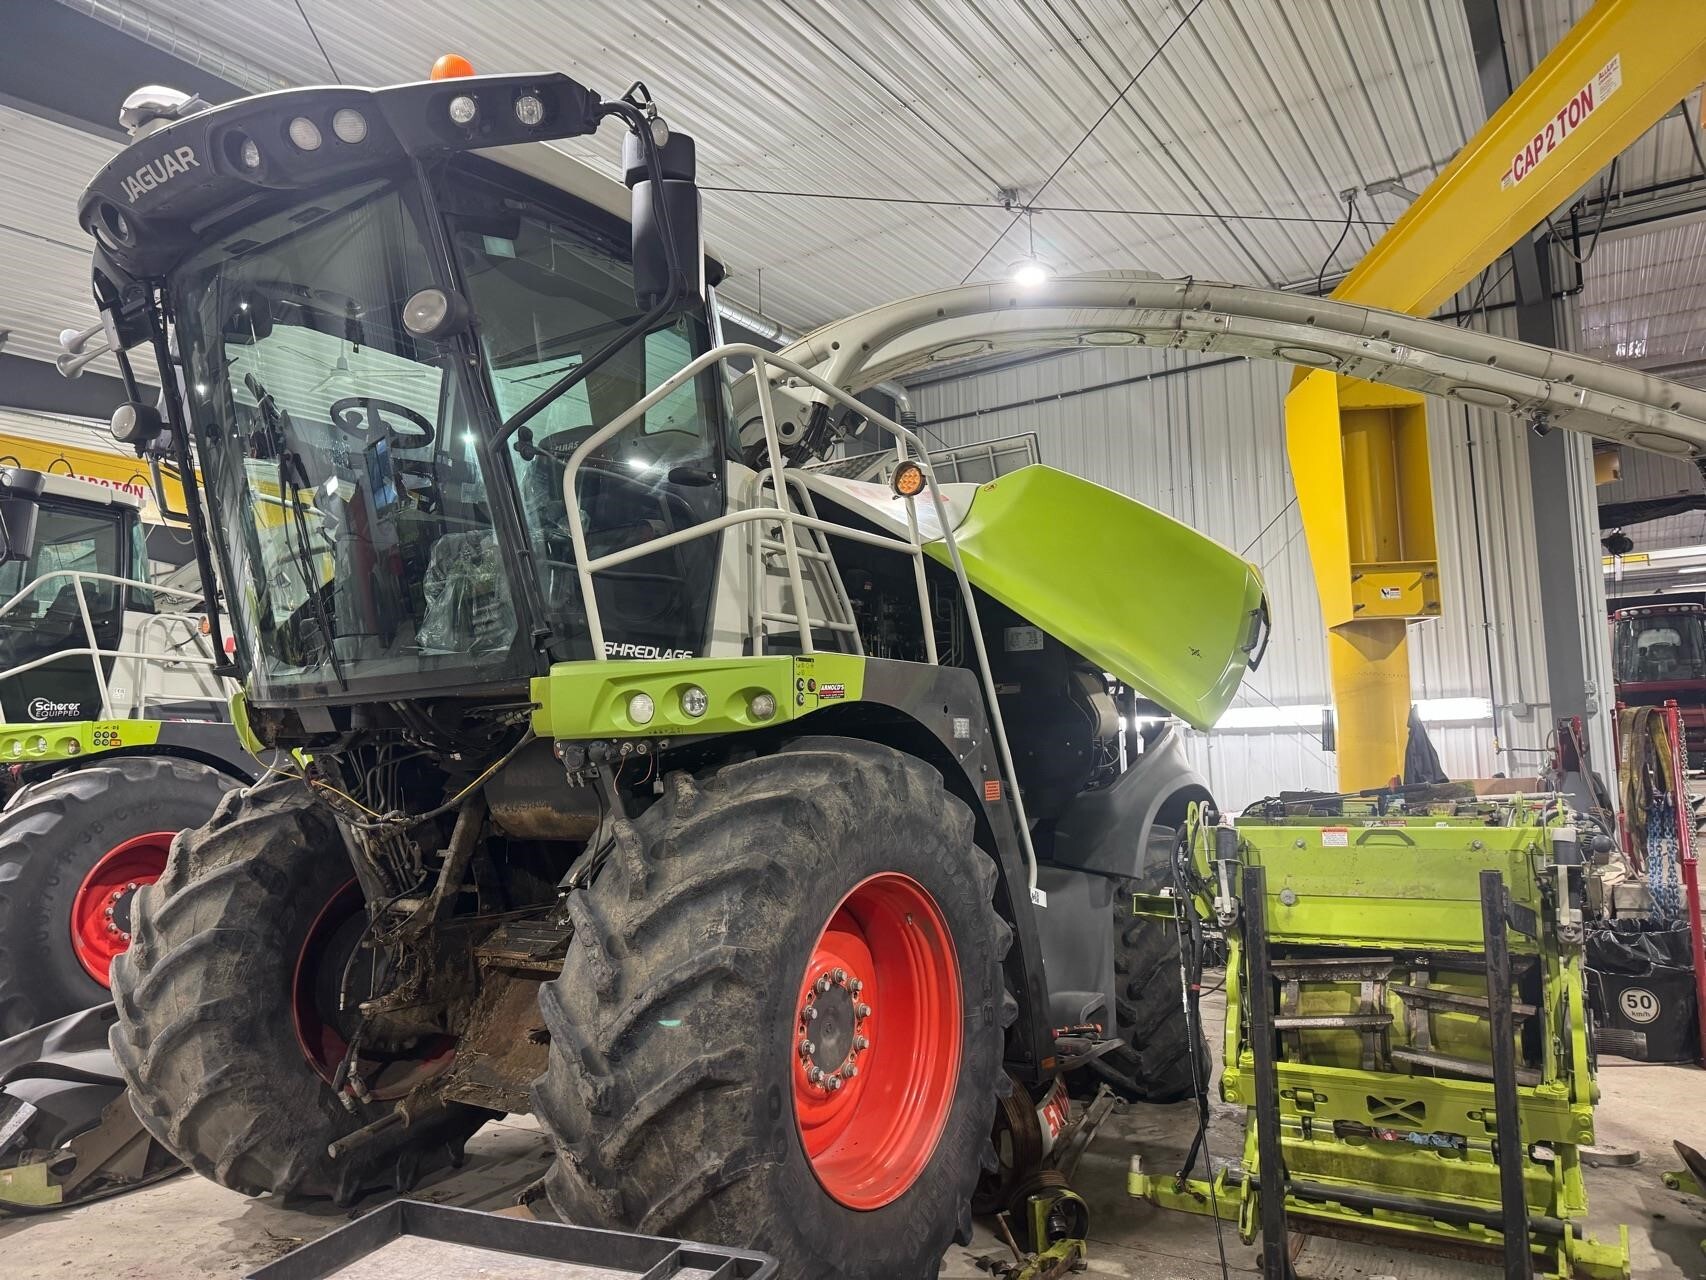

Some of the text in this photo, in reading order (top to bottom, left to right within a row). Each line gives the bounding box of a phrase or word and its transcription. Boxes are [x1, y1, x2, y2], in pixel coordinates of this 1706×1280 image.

[1513, 133, 1544, 181] CAP
[1545, 123, 1556, 153] 2
[1556, 83, 1595, 139] TON
[120, 146, 201, 204] JAGUAR
[35, 701, 81, 711] Scherer
[1627, 994, 1652, 1010] 50
